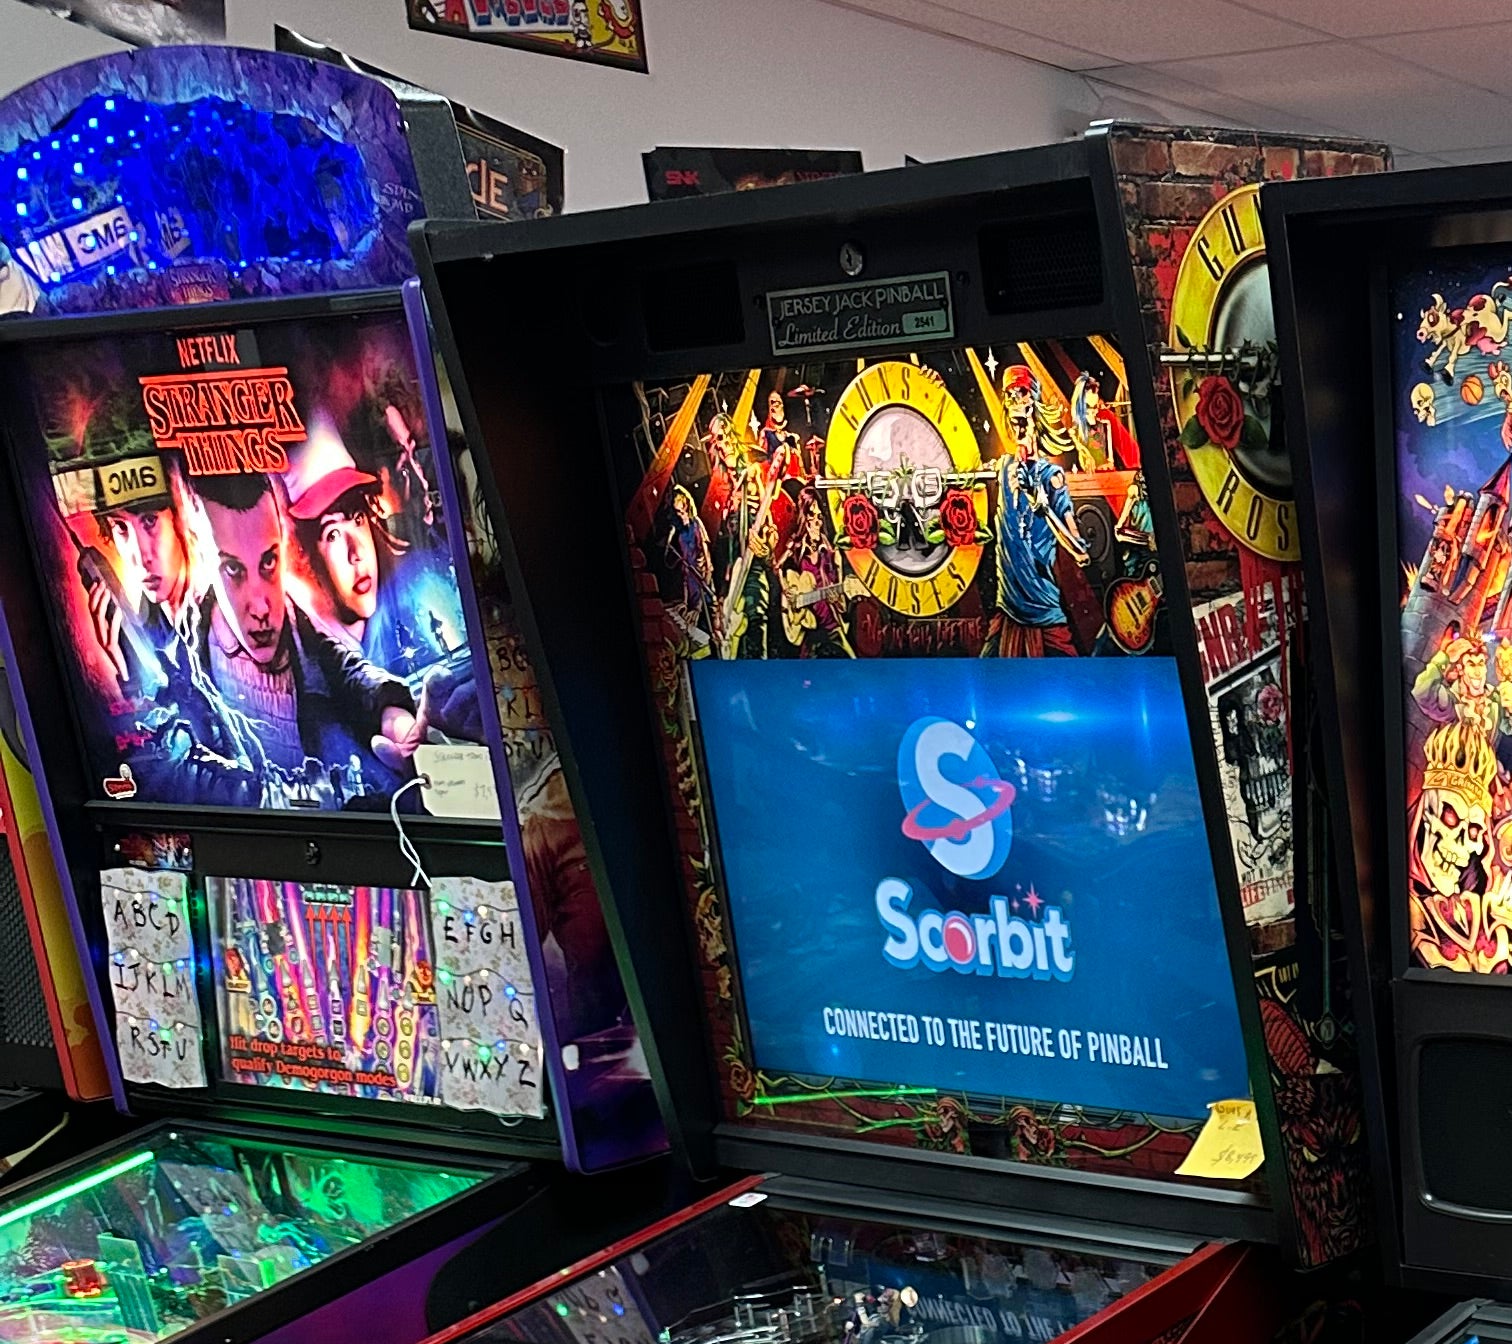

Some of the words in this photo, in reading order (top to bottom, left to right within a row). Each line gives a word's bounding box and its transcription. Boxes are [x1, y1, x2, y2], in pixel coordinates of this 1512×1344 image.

[665, 170, 699, 186] SNK
[778, 296, 831, 321] JERSEY
[833, 290, 875, 317] JACK
[876, 282, 945, 310] PINBALL
[176, 334, 240, 368] NETFLIX
[778, 318, 839, 347] Limited
[843, 314, 900, 340] Edition
[143, 377, 306, 439] STRANGER
[840, 366, 910, 430] GUNS
[179, 431, 290, 475] THINGS
[864, 561, 966, 615] ROSES
[875, 878, 1076, 982] Scorbit
[229, 1036, 247, 1050] Hit
[250, 1038, 278, 1058] drop
[280, 1041, 325, 1061] targets
[327, 1049, 342, 1062] to
[823, 1007, 919, 1044] CONNECTED
[921, 1016, 946, 1047] TO
[947, 1018, 983, 1051] THE
[985, 1022, 1056, 1058] FUTURE
[1058, 1029, 1082, 1060] OF
[1086, 1031, 1169, 1070] PINBALL
[231, 1058, 273, 1074] qualify
[276, 1061, 353, 1083] Demogorgon
[356, 1072, 397, 1087] modes
